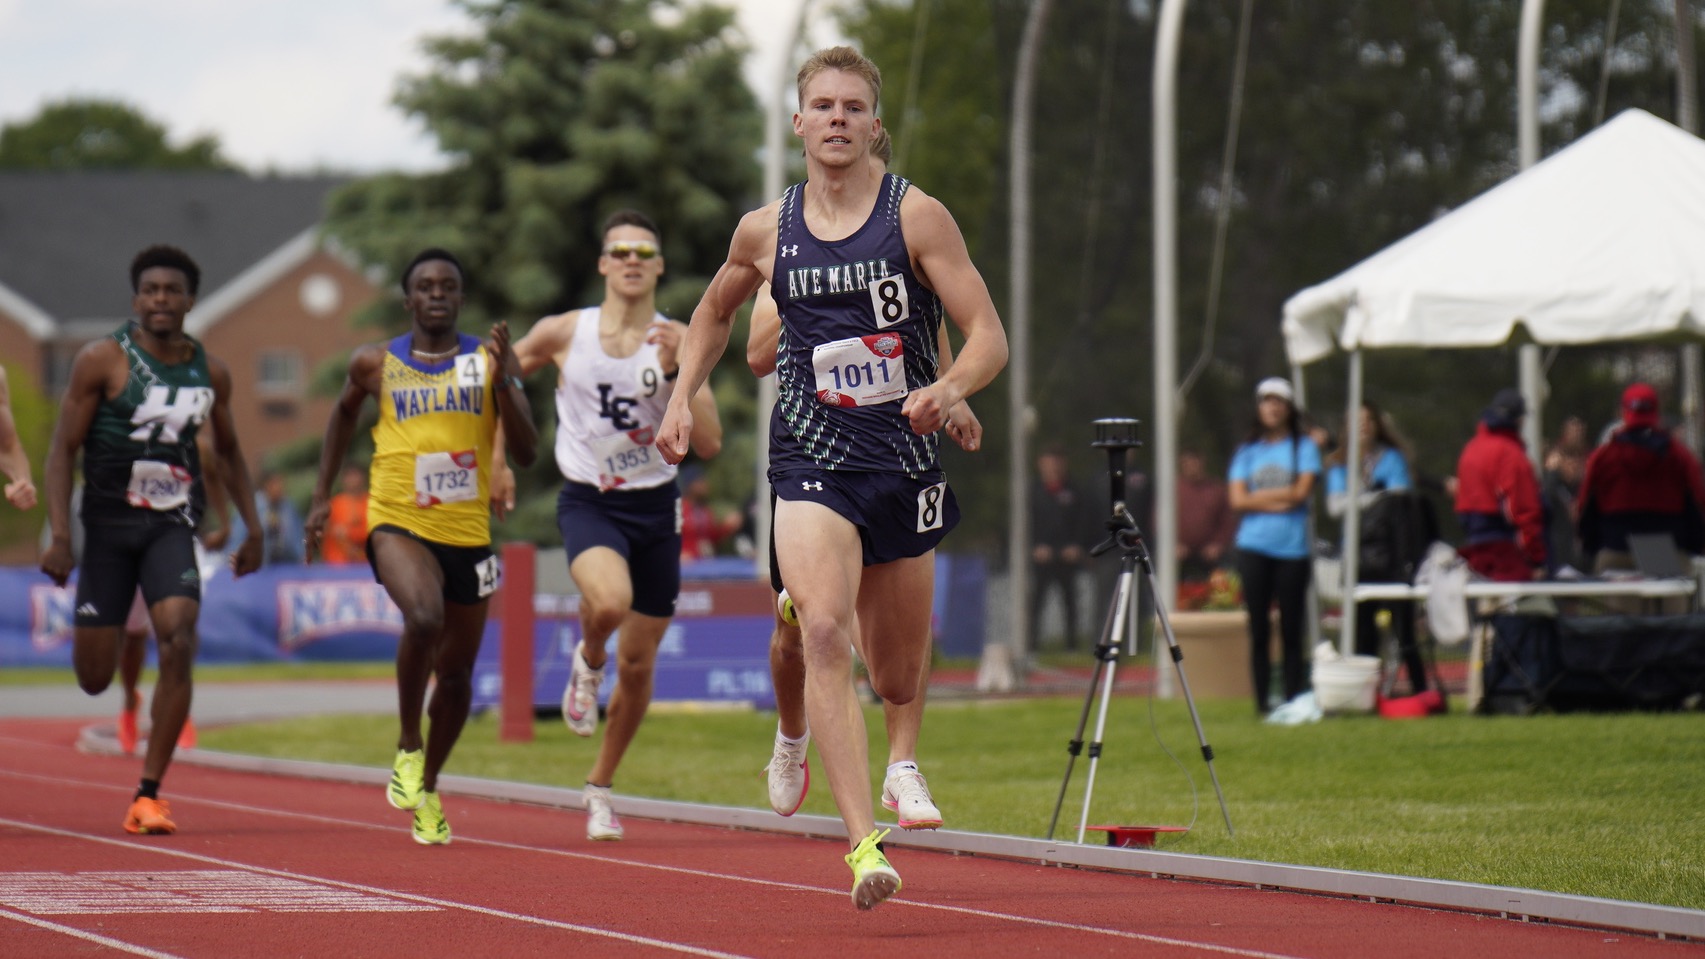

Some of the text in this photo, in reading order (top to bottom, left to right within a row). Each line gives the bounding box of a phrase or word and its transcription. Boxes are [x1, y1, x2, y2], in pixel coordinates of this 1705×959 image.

[788, 267, 822, 298] AVE
[878, 280, 903, 323] 8
[462, 357, 480, 383] 4
[642, 368, 657, 398] 9
[829, 358, 890, 390] 1011
[391, 384, 483, 422] WAYLAND
[605, 446, 650, 473] 1353
[423, 469, 469, 492] 1732
[922, 485, 940, 528] 8
[483, 560, 495, 588] 4
